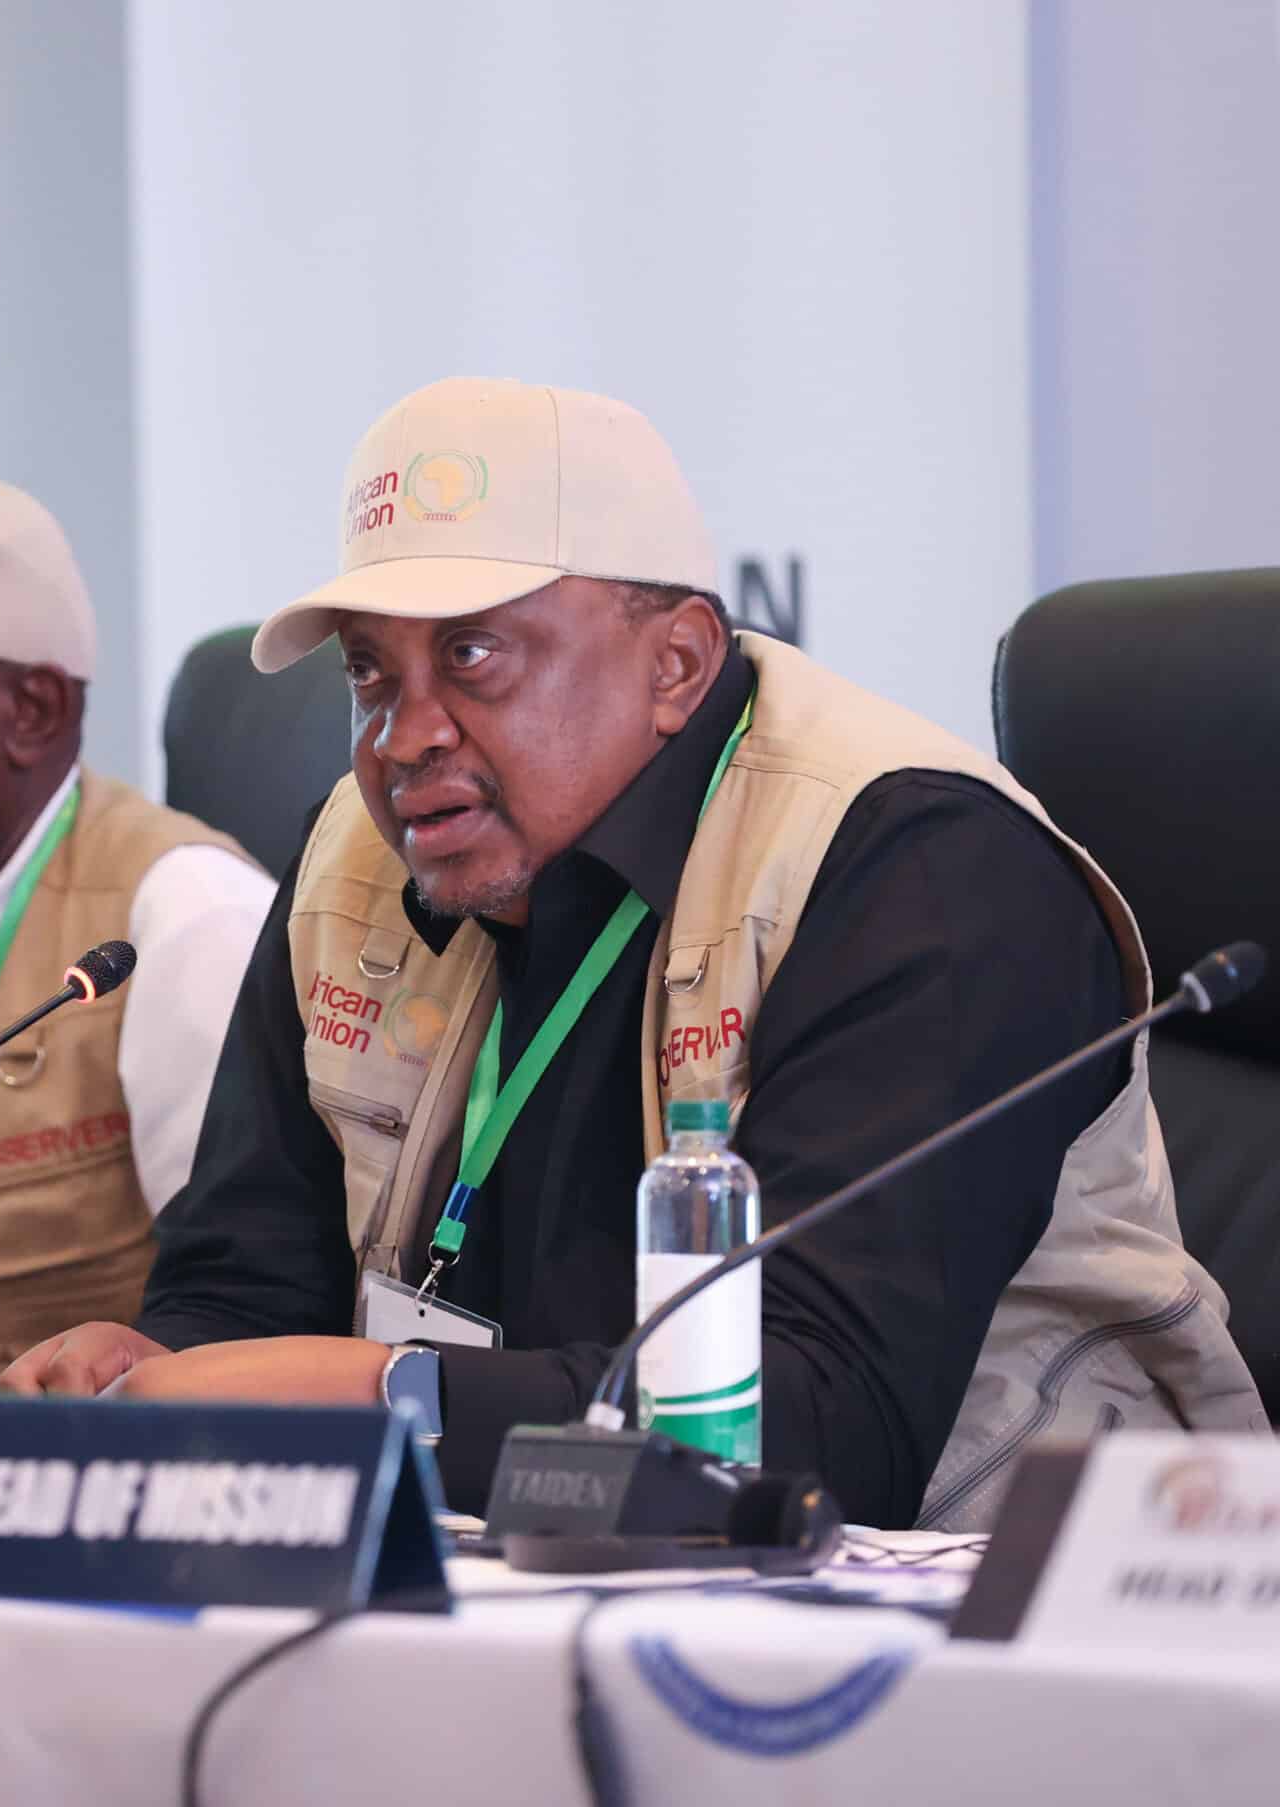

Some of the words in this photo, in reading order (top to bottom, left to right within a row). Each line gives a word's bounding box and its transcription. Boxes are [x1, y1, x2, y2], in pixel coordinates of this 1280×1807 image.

[657, 1007, 747, 1087] OERVR
[74, 1458, 144, 1541] OF
[136, 1459, 360, 1547] MISSION
